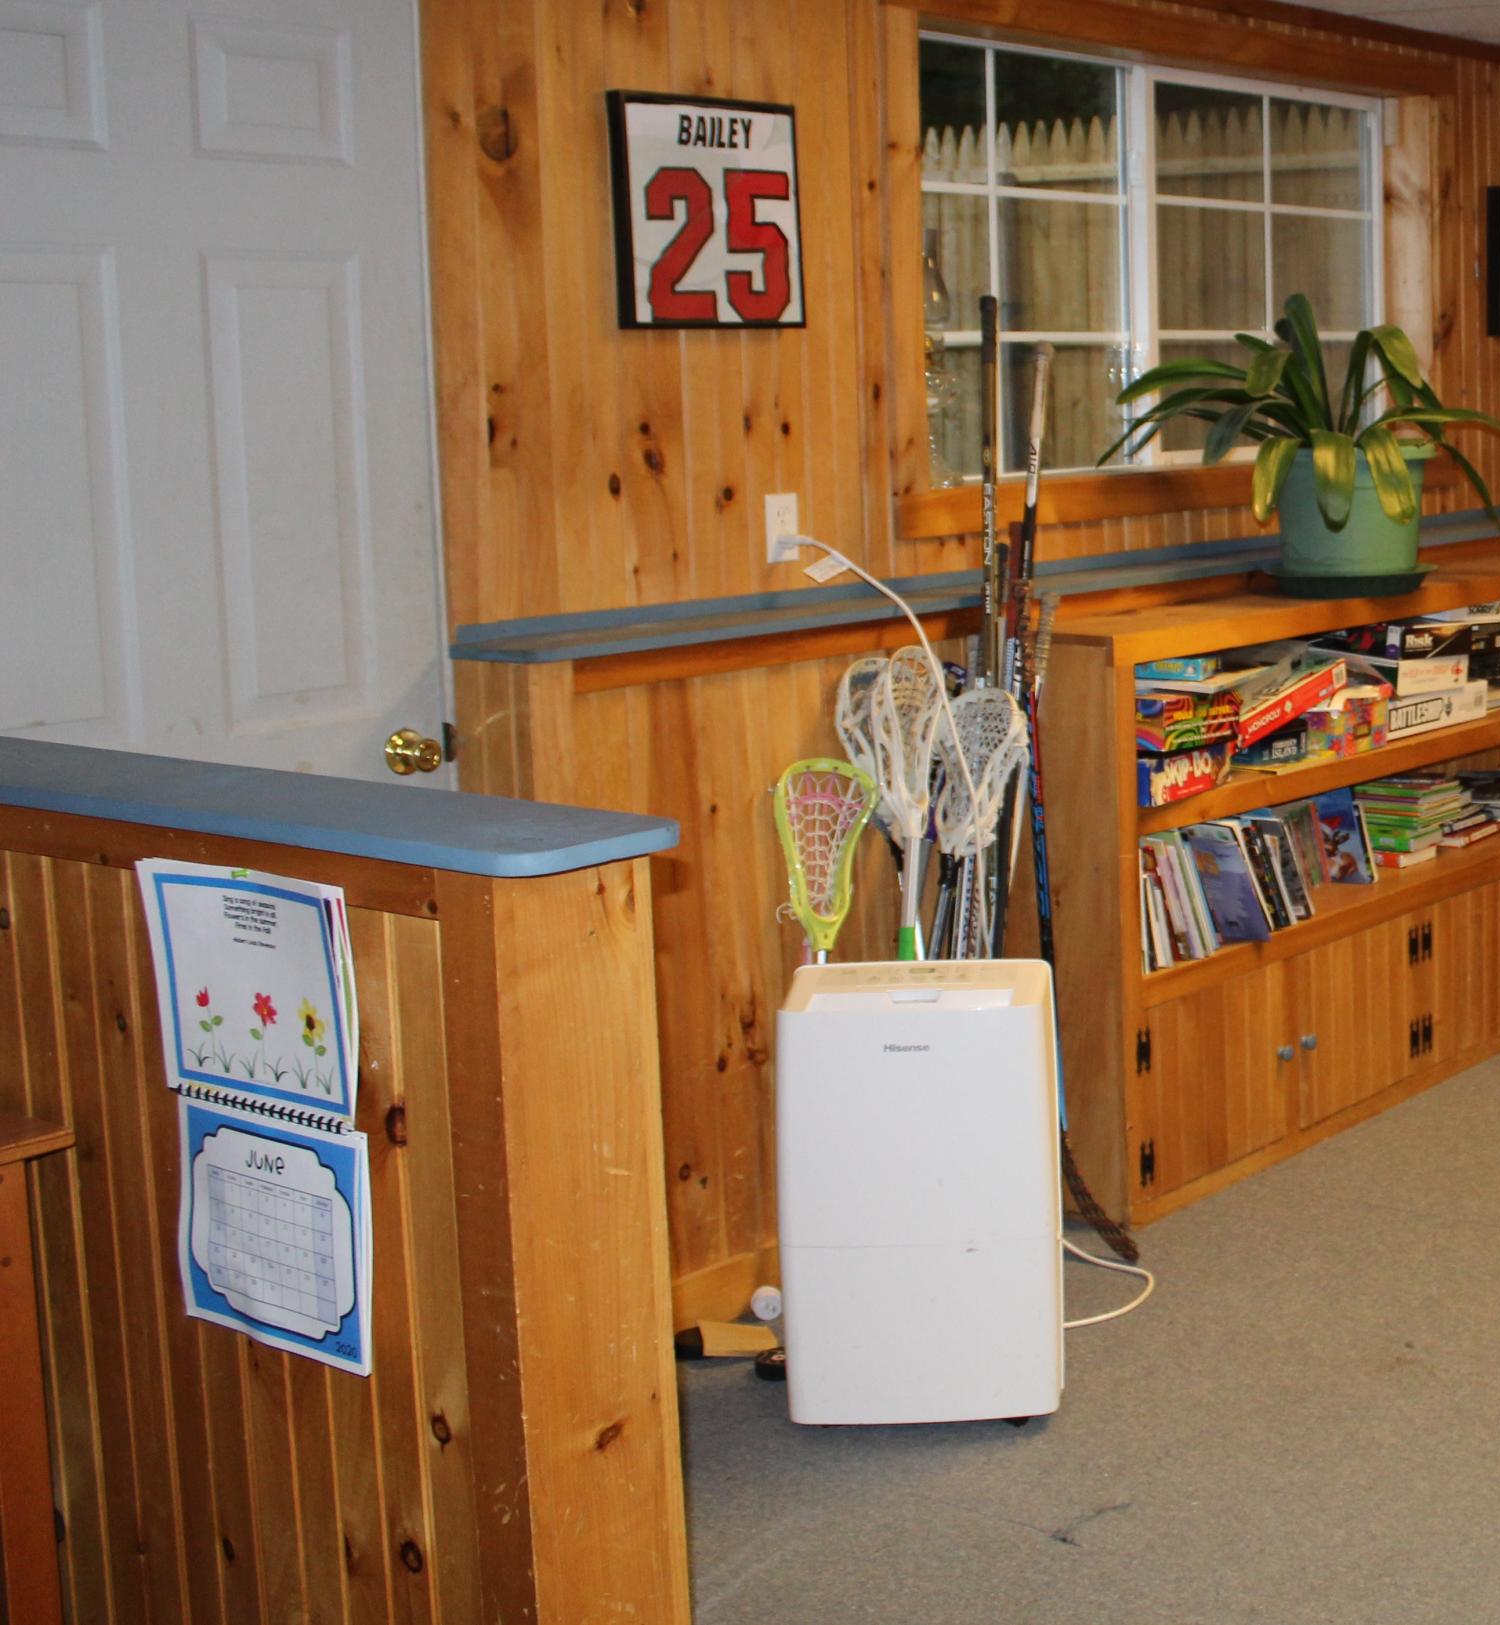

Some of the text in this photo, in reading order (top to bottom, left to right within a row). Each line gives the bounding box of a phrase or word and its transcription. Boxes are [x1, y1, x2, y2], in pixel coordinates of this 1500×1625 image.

[677, 114, 752, 149] BAILEY
[644, 166, 790, 322] 25
[983, 482, 993, 566] EASTON
[1247, 707, 1282, 733] MONOPOLY
[883, 1043, 930, 1052] Hisense
